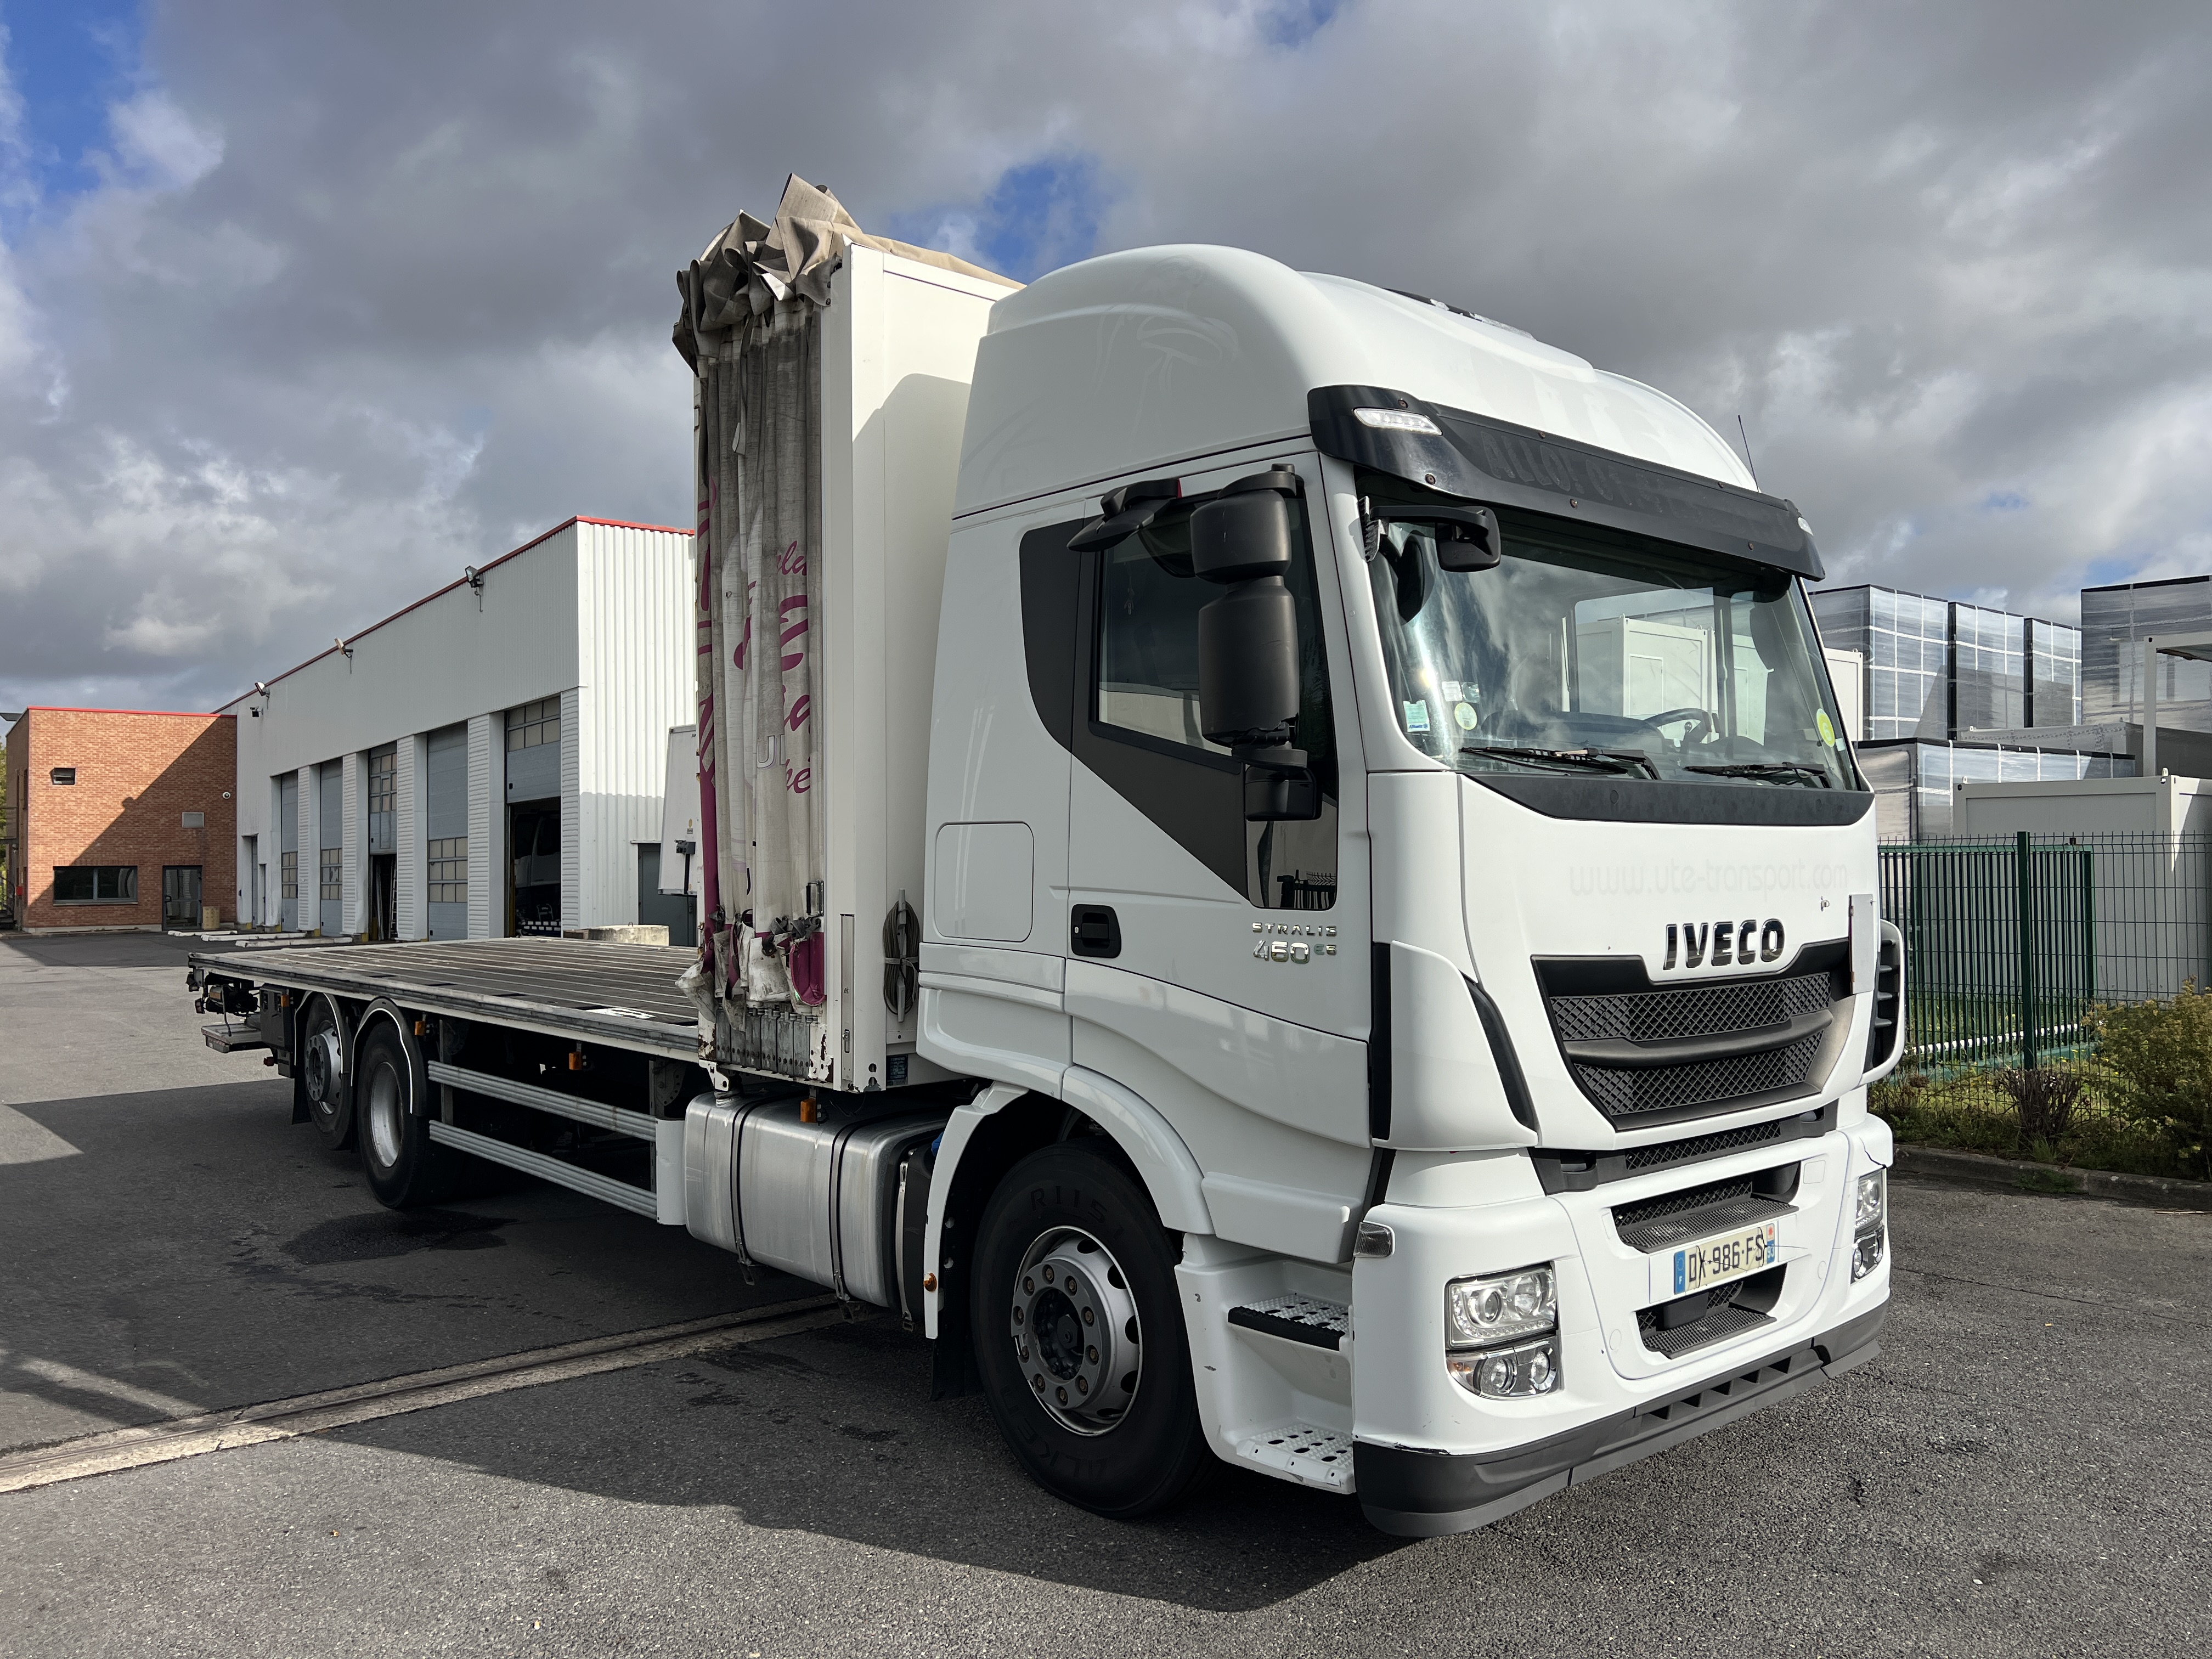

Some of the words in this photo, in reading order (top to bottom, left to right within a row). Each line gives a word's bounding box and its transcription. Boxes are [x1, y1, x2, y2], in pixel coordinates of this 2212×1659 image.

[1252, 922, 1337, 936] STRALIS
[1252, 940, 1310, 964] 460
[1663, 918, 1785, 970] IVECO
[1678, 1275, 1683, 1285] F
